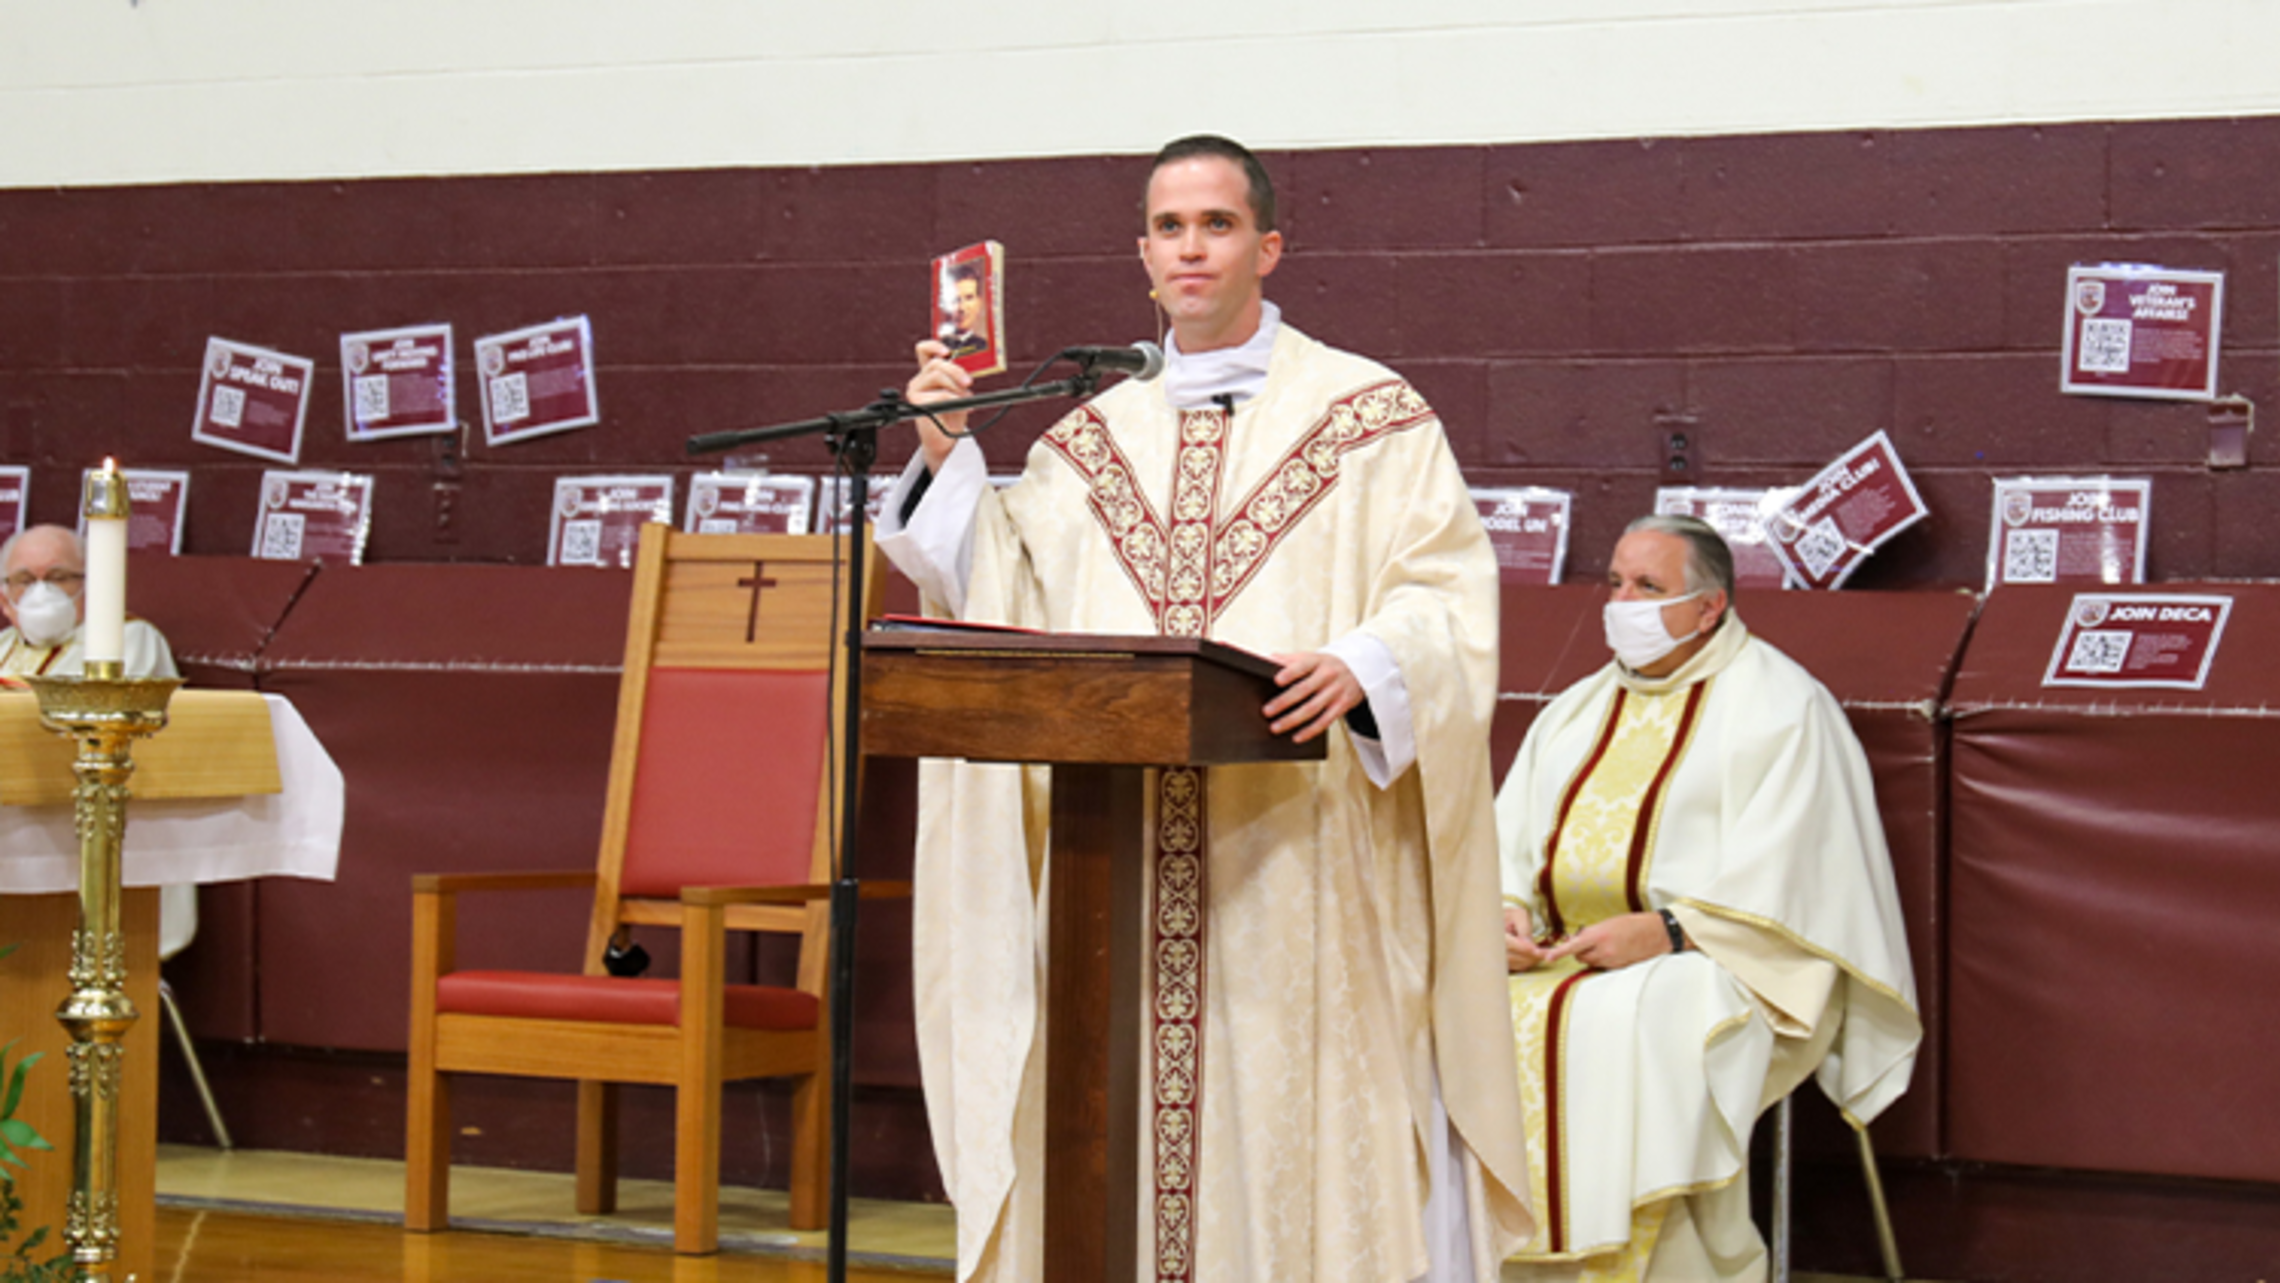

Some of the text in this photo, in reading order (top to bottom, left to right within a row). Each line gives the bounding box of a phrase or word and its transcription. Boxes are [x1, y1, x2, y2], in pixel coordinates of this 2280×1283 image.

[2147, 284, 2177, 296] JOIN
[229, 365, 268, 388] SPEAK
[2031, 506, 2141, 524] FISHING CLUB
[2109, 605, 2212, 622] JOIN DECA
